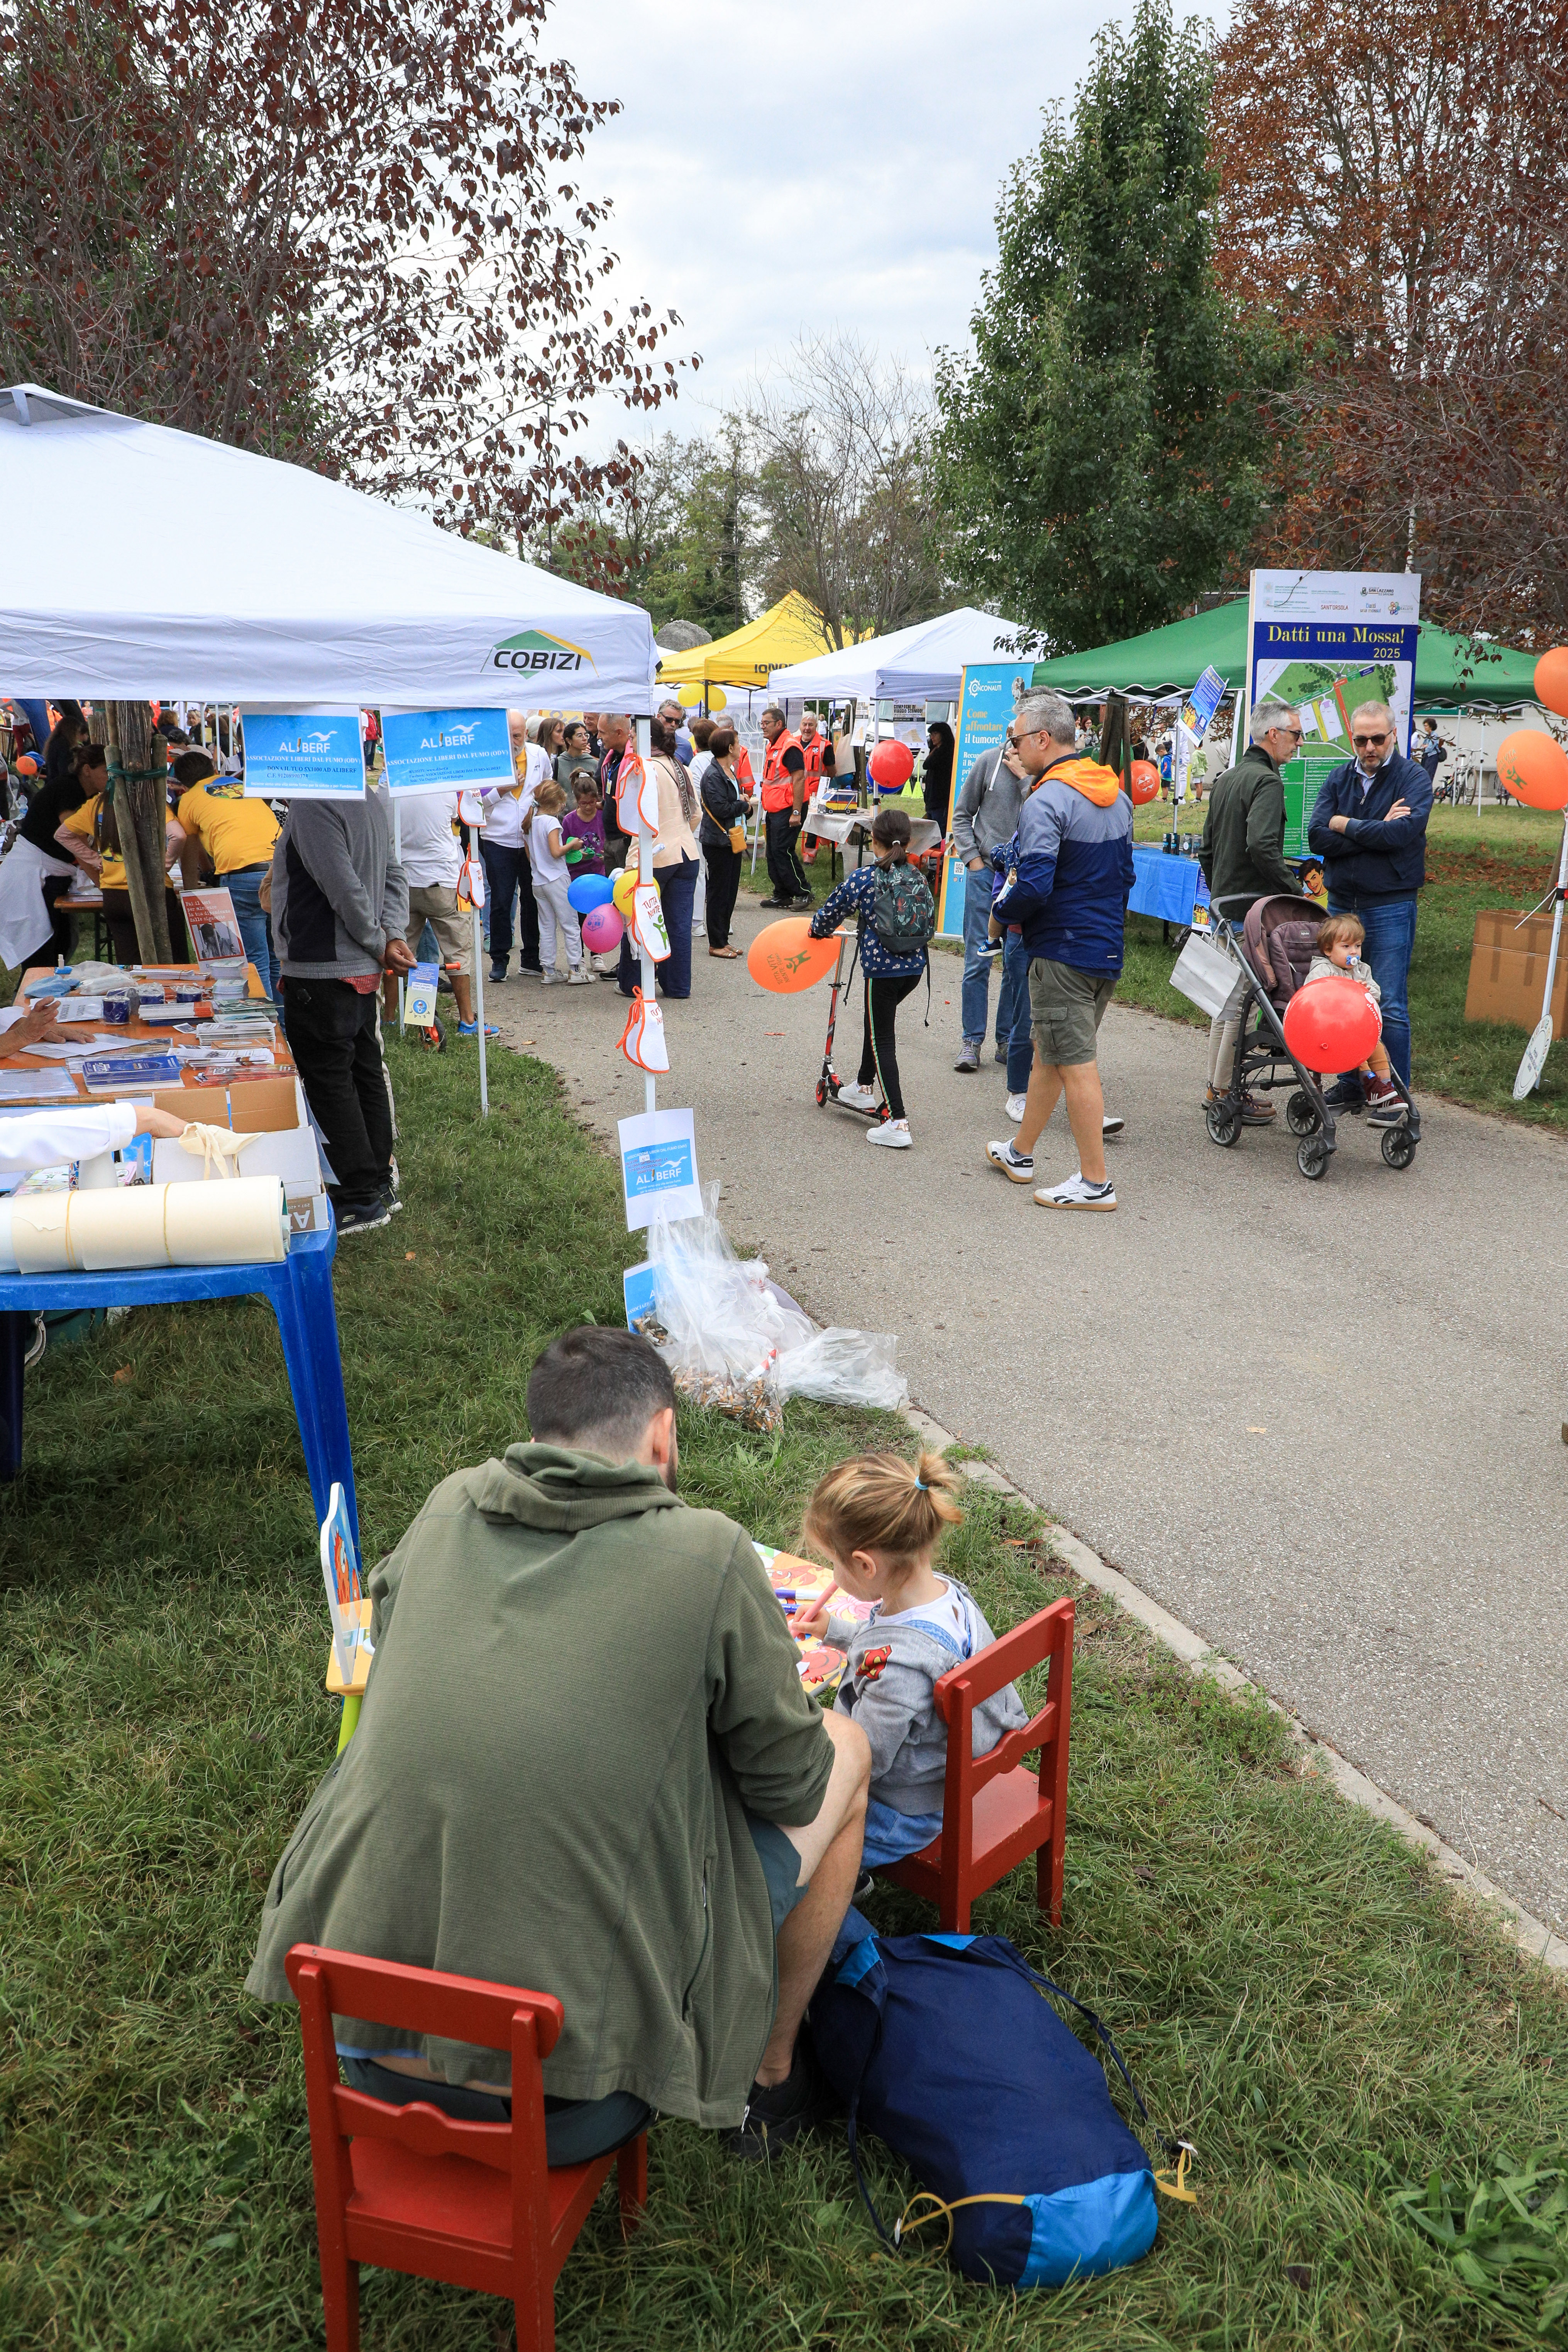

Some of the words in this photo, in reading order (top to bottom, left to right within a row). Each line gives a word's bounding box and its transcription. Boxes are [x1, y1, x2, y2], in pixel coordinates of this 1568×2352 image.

[1267, 626, 1310, 642] Datti
[1316, 631, 1347, 642] una
[1353, 627, 1405, 643] Mossa!
[1373, 648, 1400, 658] 2025
[494, 651, 582, 671] COBIZI
[970, 682, 1002, 692] ONCONAUTI
[967, 708, 988, 718] Come
[966, 720, 1003, 731] affrontare
[965, 733, 970, 743] il
[972, 734, 1002, 744] tumore?
[387, 756, 432, 766] ASSOCIAZIONE
[642, 896, 657, 909] TUTTA
[767, 954, 777, 970] VITA
[774, 971, 783, 985] TUTTA
[1366, 1003, 1378, 1020] dona
